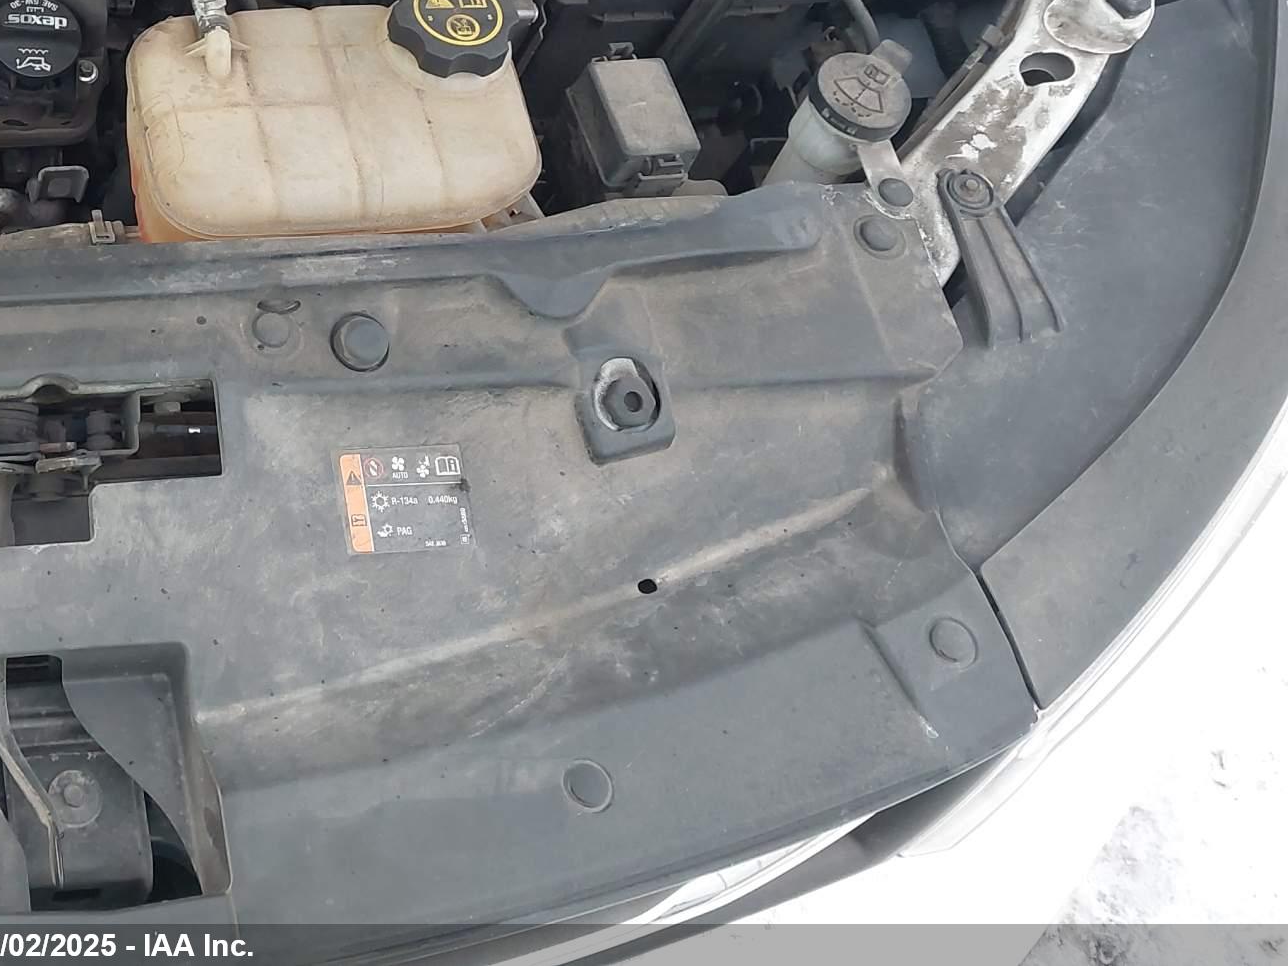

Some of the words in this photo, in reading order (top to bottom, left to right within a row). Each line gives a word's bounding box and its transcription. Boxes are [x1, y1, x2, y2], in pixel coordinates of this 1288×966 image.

[42, 0, 58, 11] SAE
[7, 14, 67, 29] dexos
[392, 471, 409, 479] AUTO
[391, 497, 419, 505] R-134a
[428, 494, 458, 505] 0.440kg
[396, 526, 413, 536] PAG
